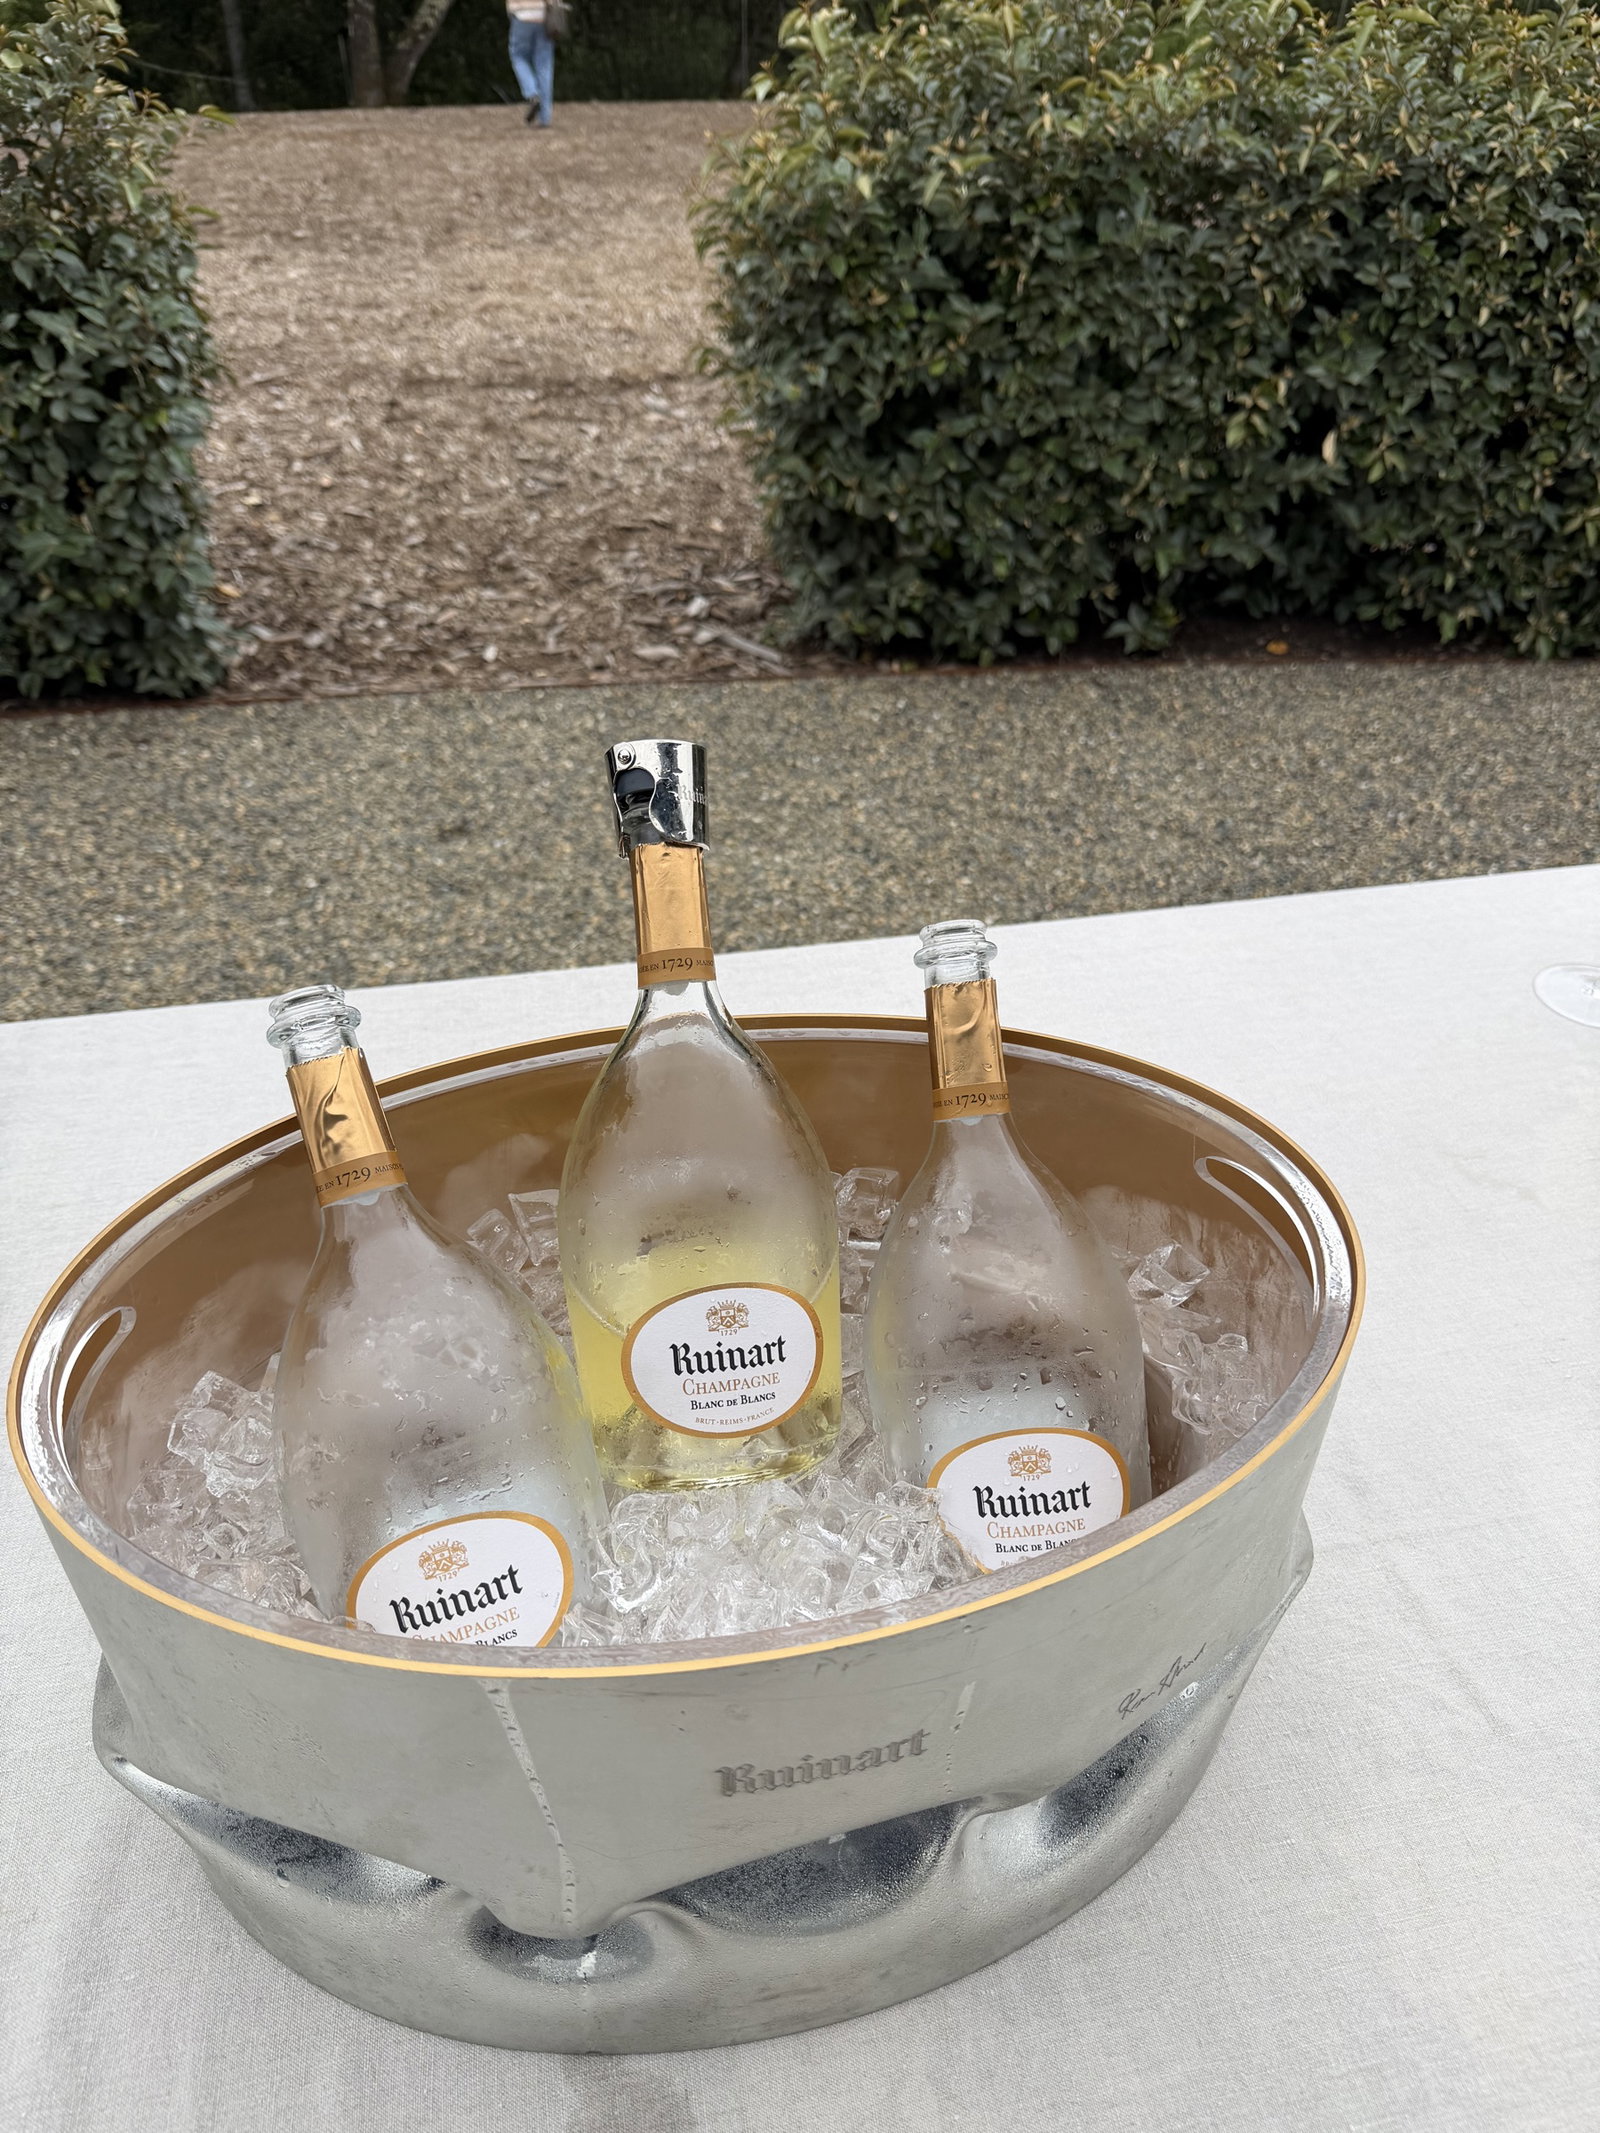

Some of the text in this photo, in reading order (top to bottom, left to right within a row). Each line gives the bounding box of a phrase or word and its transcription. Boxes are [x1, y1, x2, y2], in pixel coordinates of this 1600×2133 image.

[661, 957, 693, 973] 1729
[955, 1093, 986, 1108] 1729
[335, 1167, 371, 1187] 1729
[669, 1335, 787, 1377] Ruinart
[682, 1372, 781, 1397] CHAMPAGNE
[690, 1392, 776, 1411] BLANC DE BLANCS
[972, 1481, 1092, 1519] Ruinart
[986, 1518, 1086, 1539] CHAMPAGNE
[995, 1543, 1029, 1553] BLANC
[1031, 1543, 1043, 1552] DE
[438, 1570, 459, 1582] 1729
[389, 1564, 523, 1634] Ruinart
[715, 1728, 931, 1797] Ruinart
